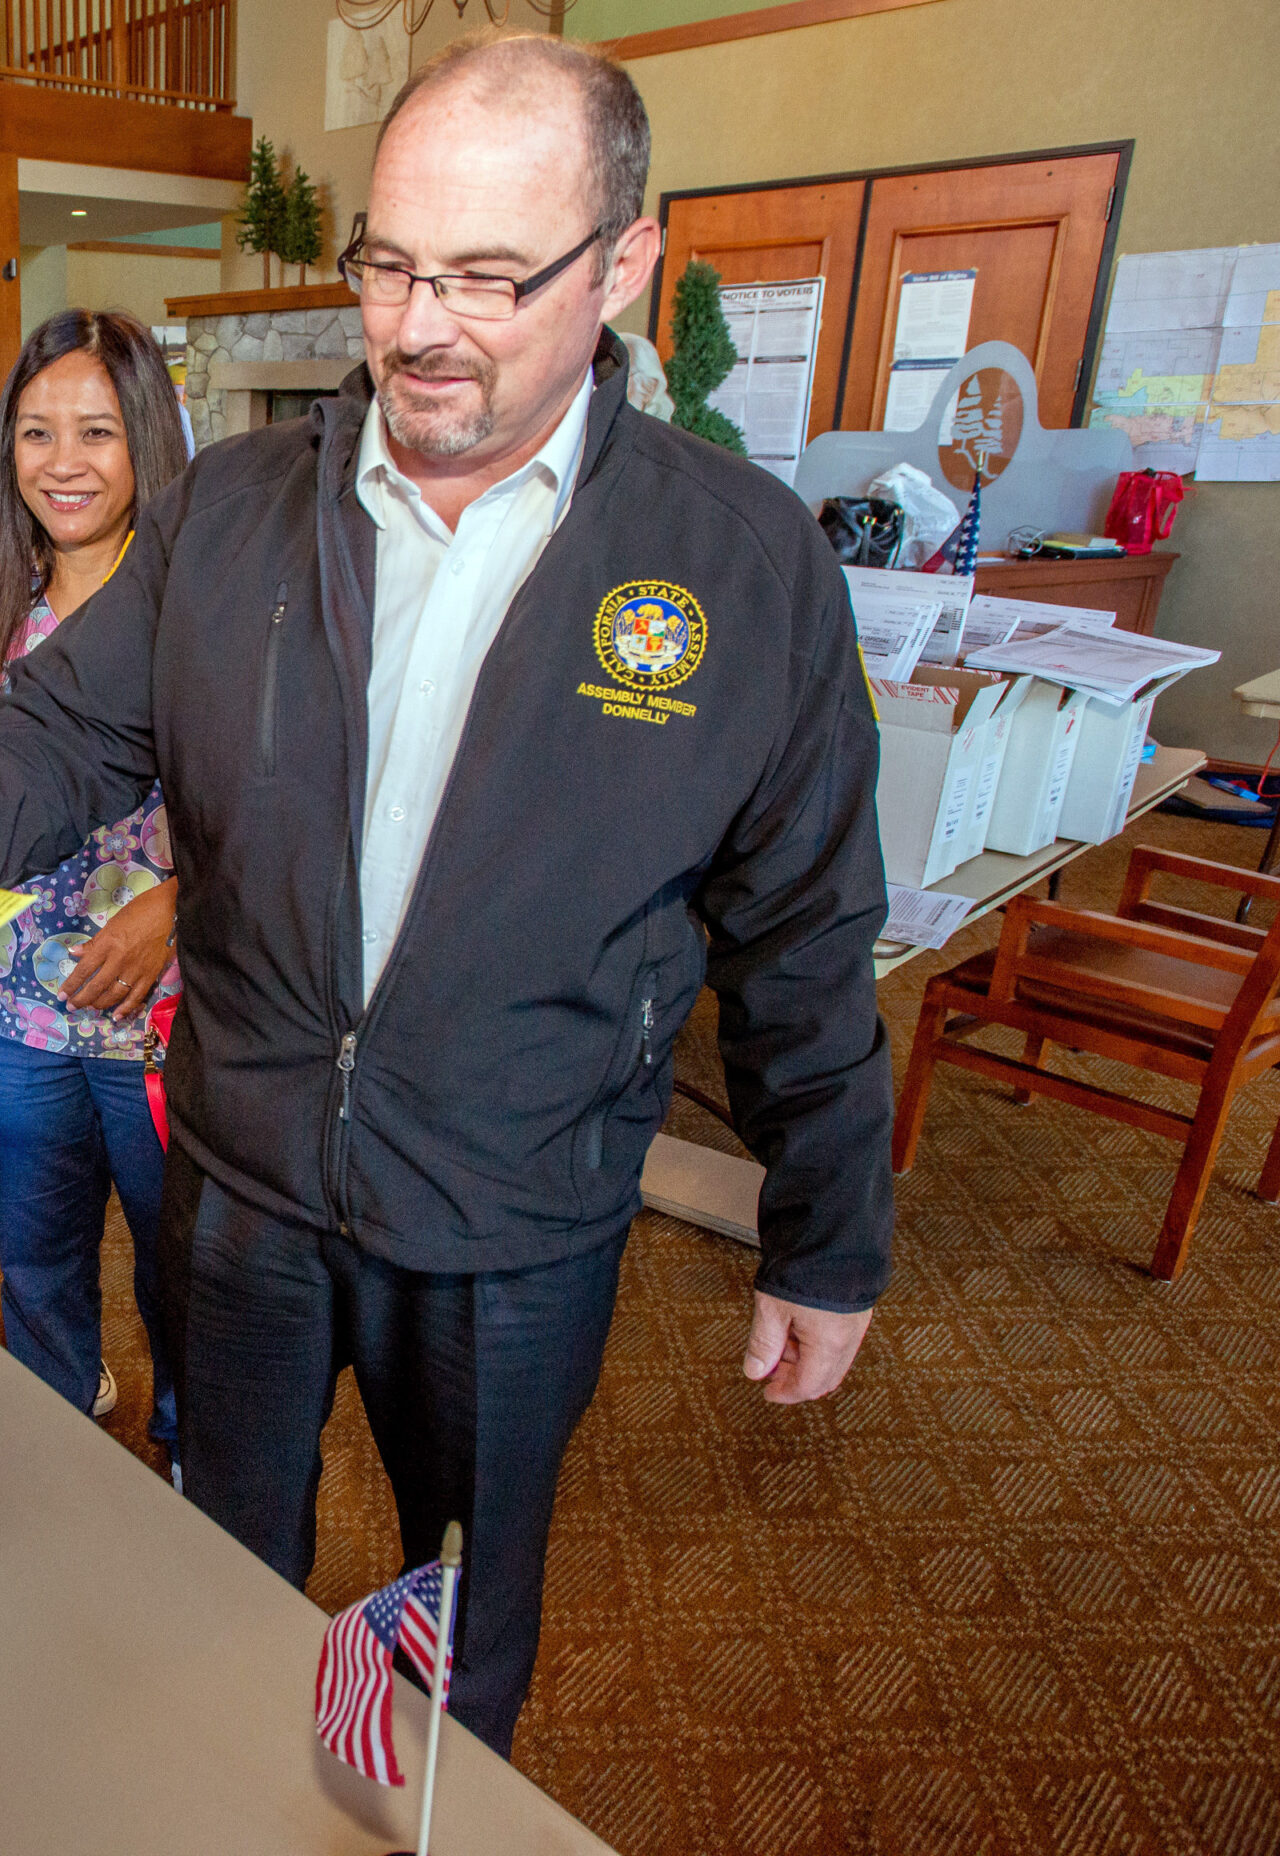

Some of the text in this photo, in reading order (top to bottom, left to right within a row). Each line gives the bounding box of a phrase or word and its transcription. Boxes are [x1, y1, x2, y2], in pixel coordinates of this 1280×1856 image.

[721, 286, 814, 300] NOTICE TO VOTERS
[599, 585, 702, 685] CALIFORNIA STATE ASSEMBLY
[901, 684, 930, 693] EVIDENT
[907, 690, 925, 698] TAPE
[576, 681, 697, 718] ASSEMBLY MEMBER
[601, 702, 670, 726] DONNELLY
